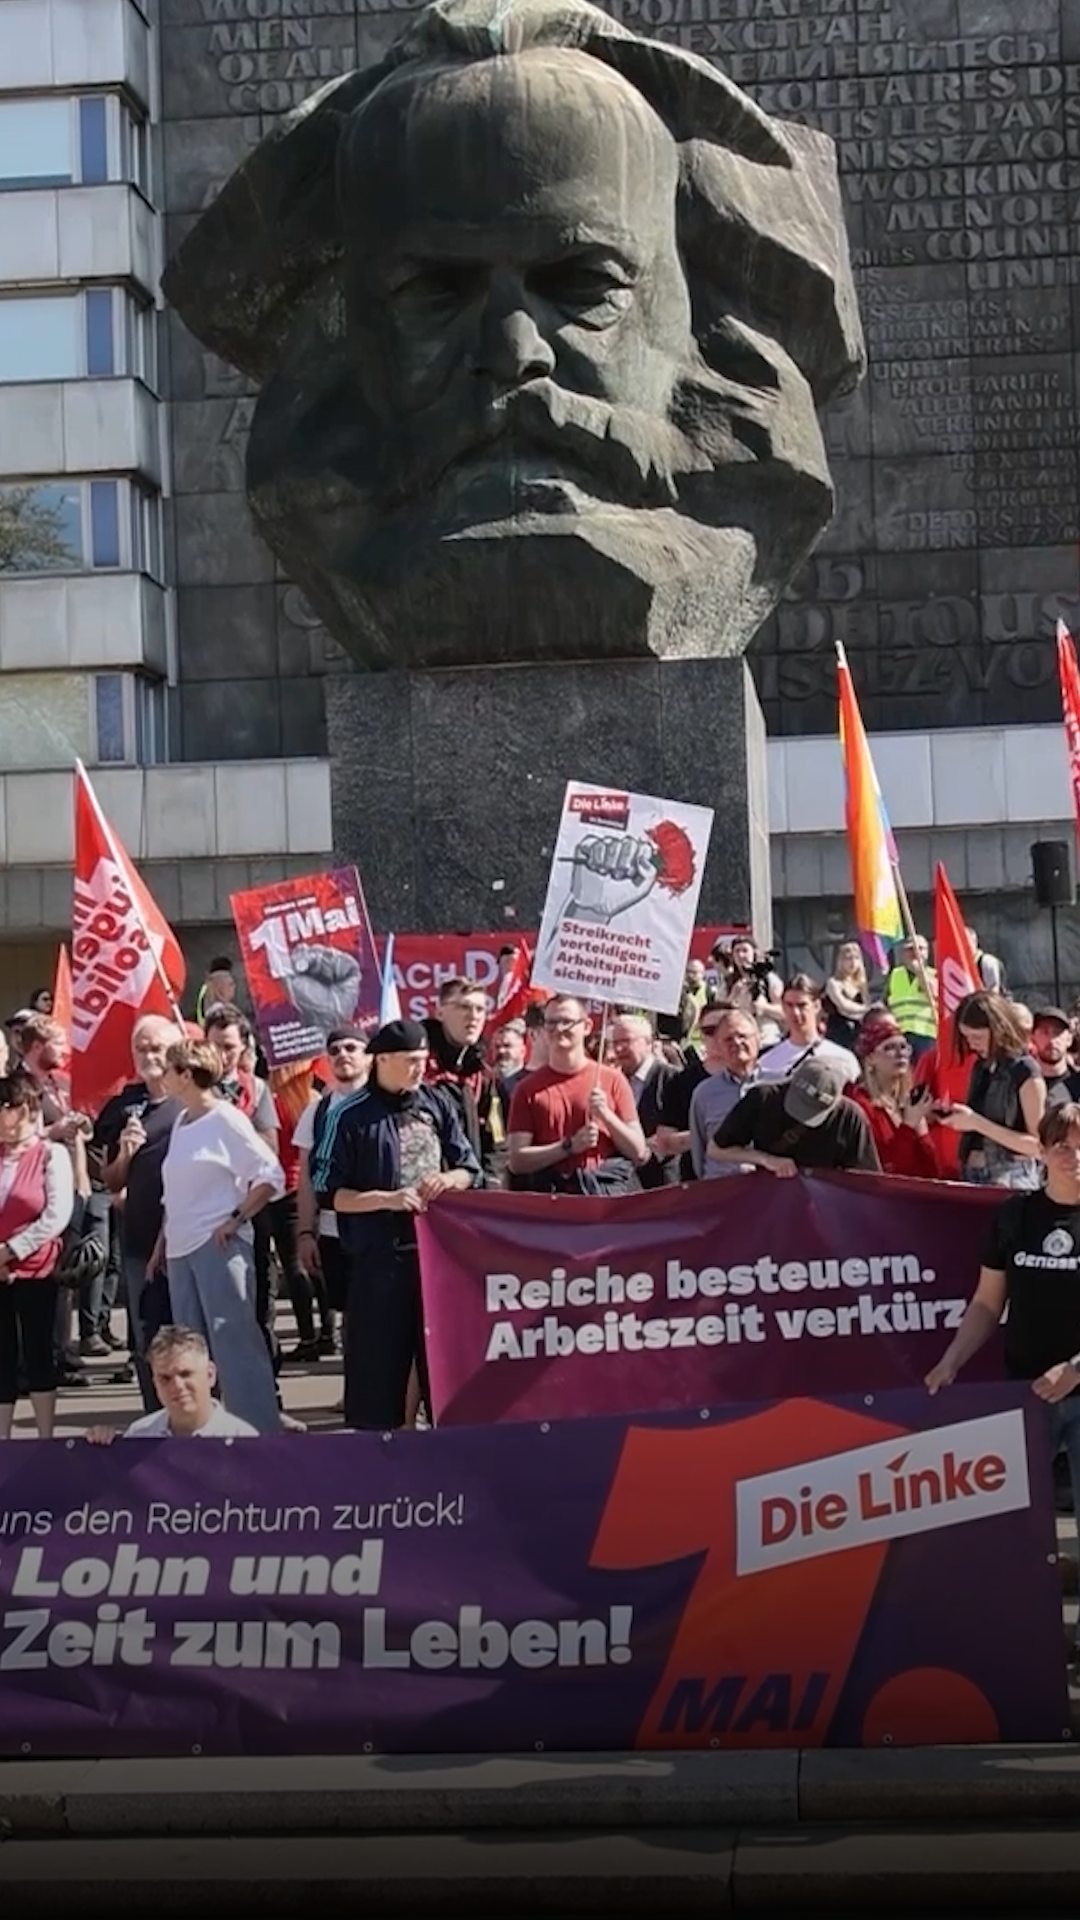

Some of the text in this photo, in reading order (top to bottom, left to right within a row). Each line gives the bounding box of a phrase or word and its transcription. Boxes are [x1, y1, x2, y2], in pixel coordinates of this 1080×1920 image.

[208, 19, 313, 50] MEN
[746, 67, 1017, 113] ROLETAIRES
[891, 103, 961, 137] LES
[973, 95, 1080, 132] PAYS
[844, 161, 1080, 201] WORKING
[887, 199, 993, 231] MEN
[286, 896, 361, 942] Mai
[561, 922, 653, 950] Streikrecht
[556, 951, 661, 981] Arbeitsplätze
[560, 938, 648, 963] verteidigen
[553, 967, 617, 988] sichern!
[485, 1253, 936, 1312] Reiche besteuern.
[485, 1294, 968, 1362] Arbeitszeit verkürz
[65, 1503, 134, 1535] den
[147, 1502, 320, 1535] Reichtum
[333, 1492, 465, 1530] zurück!
[761, 1450, 1007, 1547] Die Linke
[11, 1539, 384, 1598] Lohn und
[0, 1603, 634, 1671] Zeit zum Leben!
[656, 1672, 831, 1734] MAI
